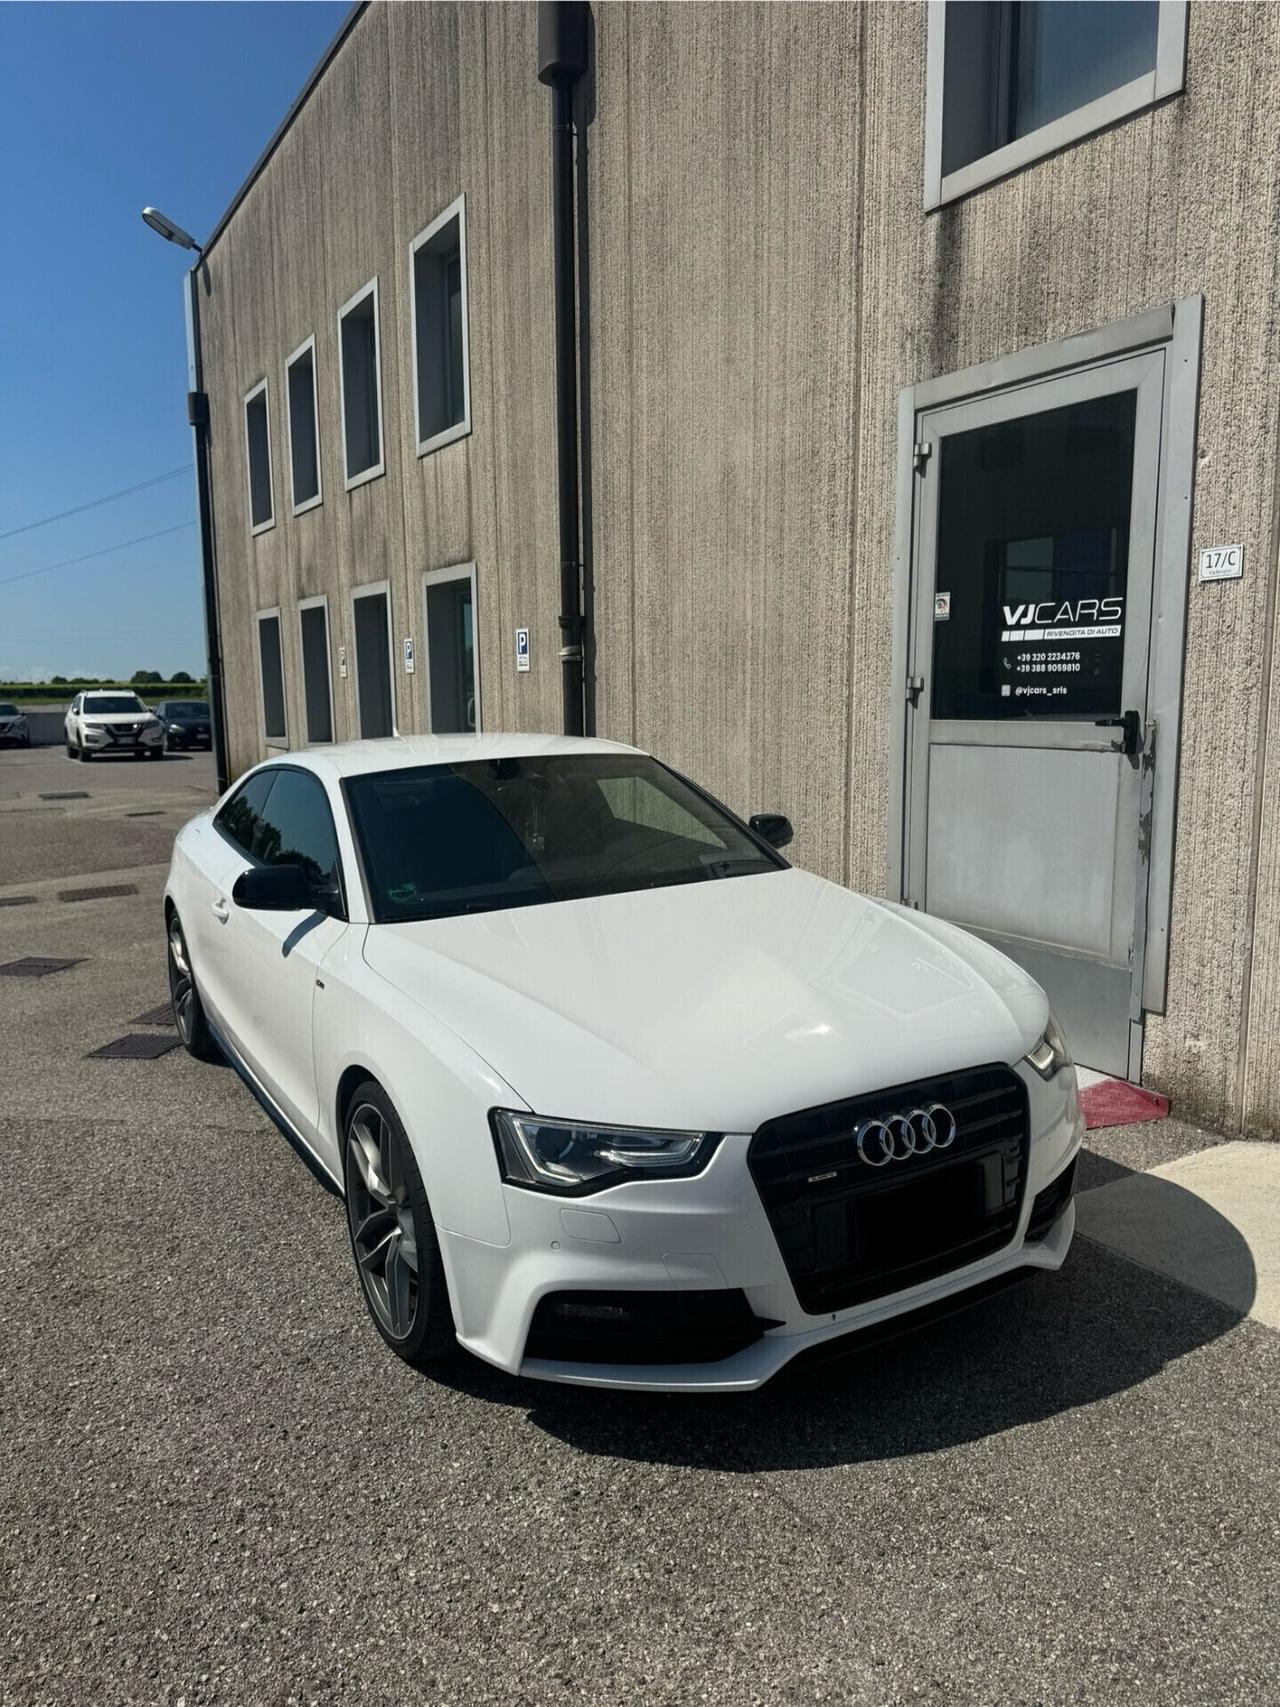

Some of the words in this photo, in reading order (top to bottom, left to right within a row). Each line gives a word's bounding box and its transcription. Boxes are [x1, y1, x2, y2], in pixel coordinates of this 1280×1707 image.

[1206, 550, 1236, 569] 17/C
[519, 633, 526, 654] P
[1017, 653, 1030, 661] +39
[1032, 653, 1046, 661] 320
